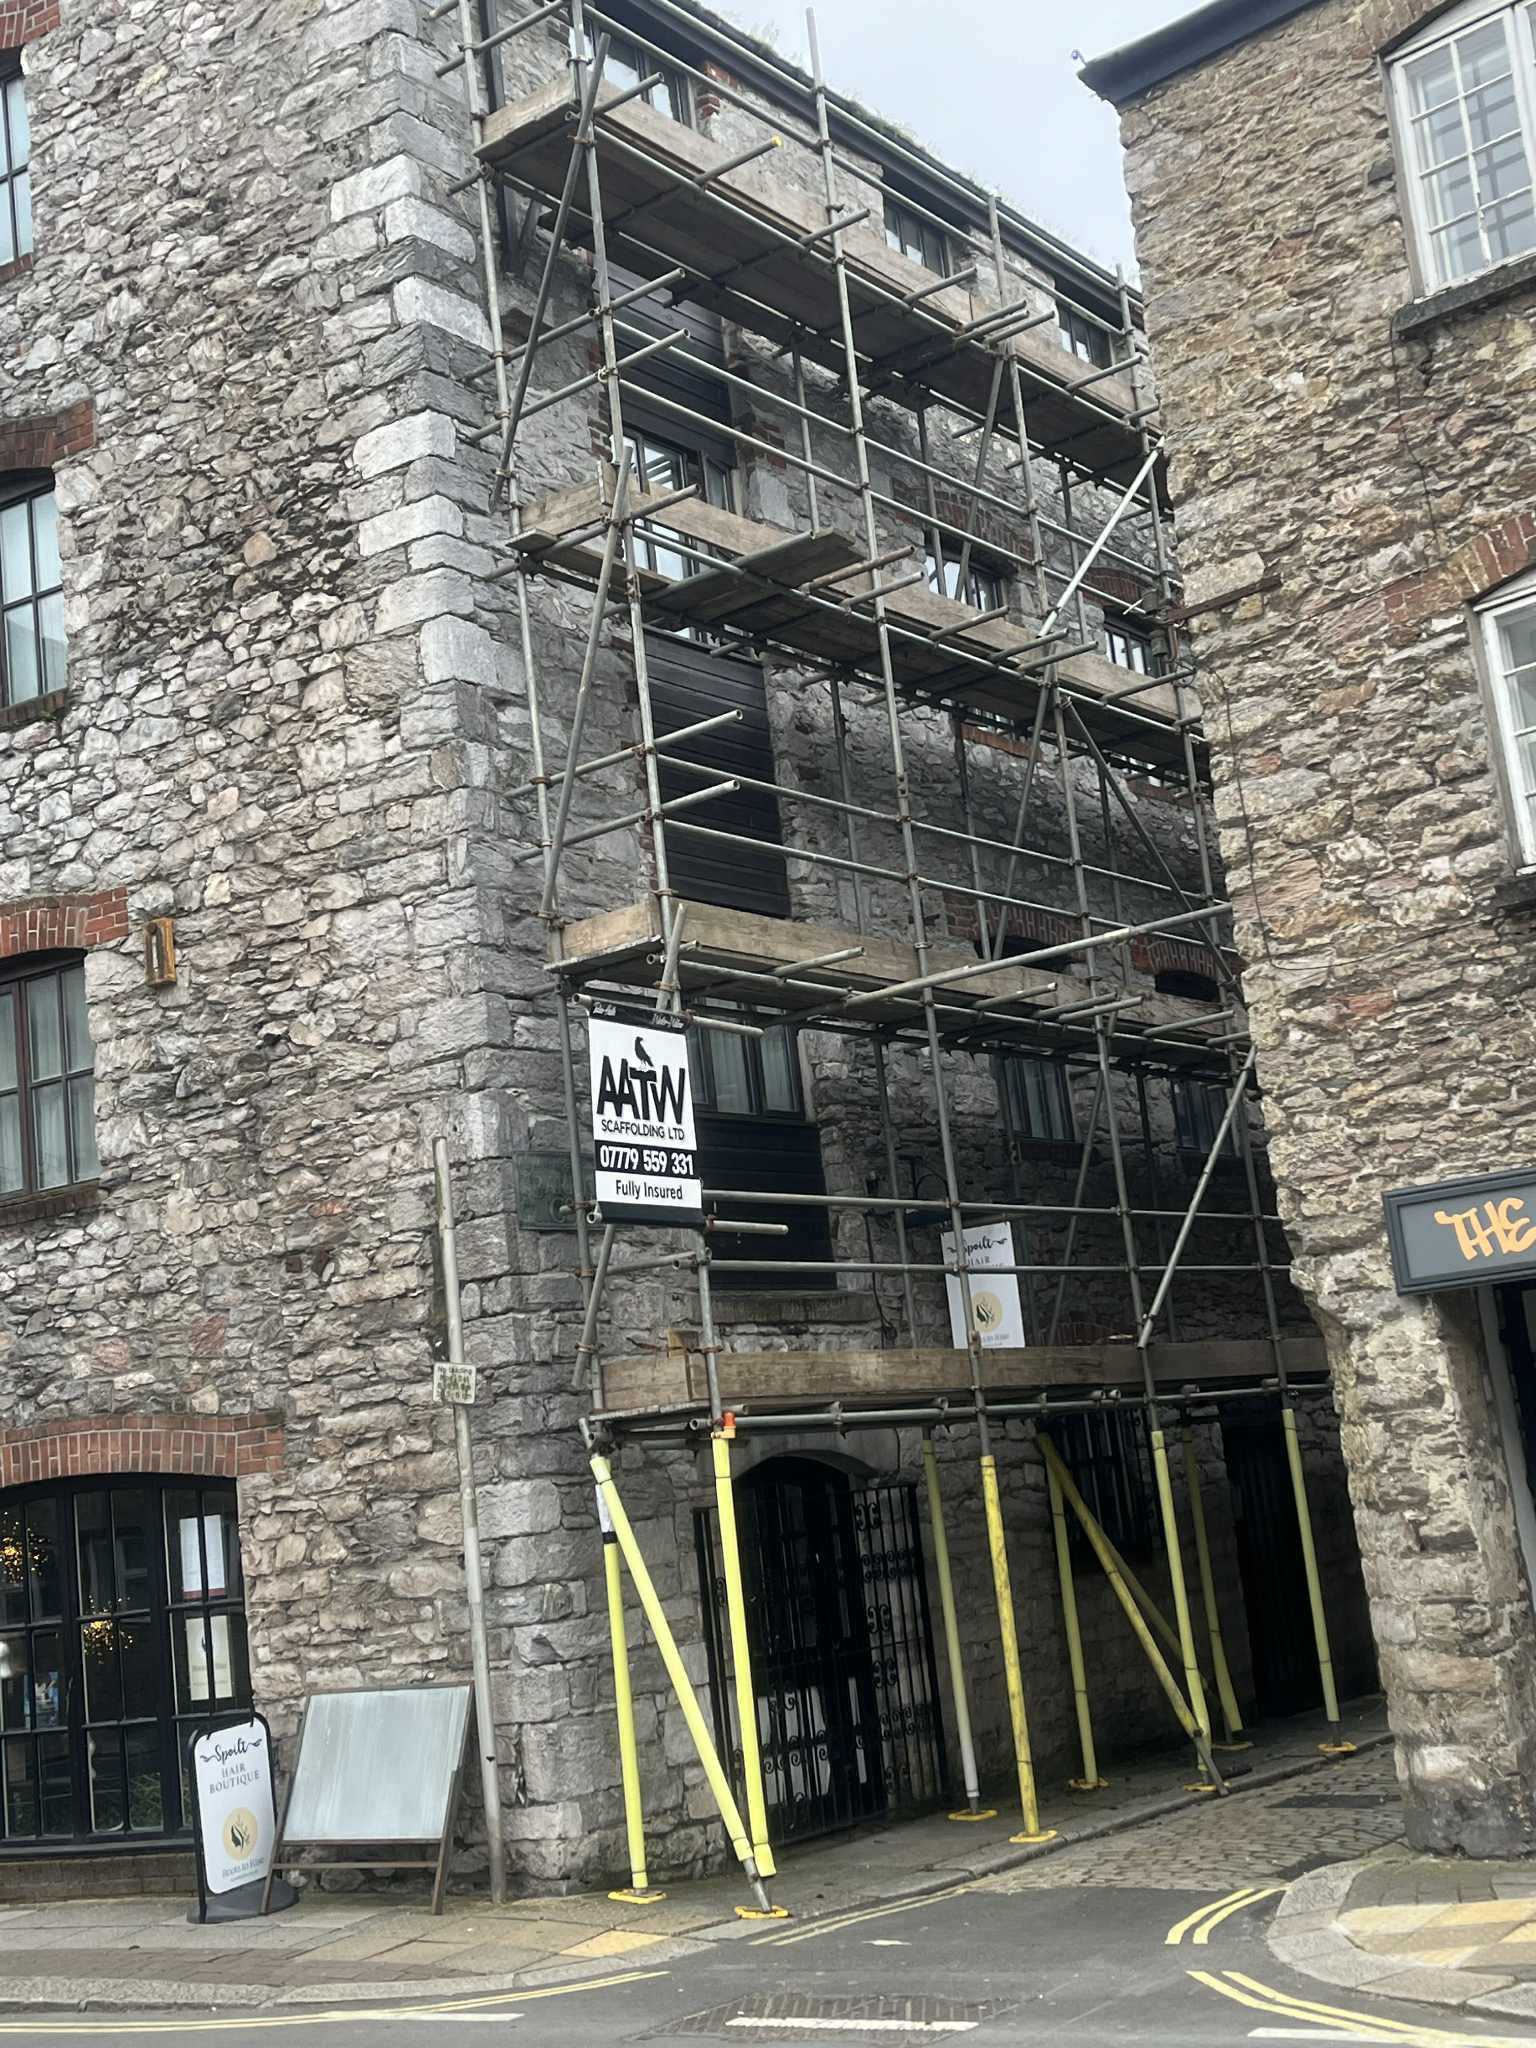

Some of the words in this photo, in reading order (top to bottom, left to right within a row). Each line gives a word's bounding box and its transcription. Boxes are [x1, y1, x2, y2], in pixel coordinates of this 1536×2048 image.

[597, 1055, 685, 1125] AATW
[602, 1119, 665, 1139] SCAFFOLDING
[668, 1127, 685, 1141] LTD
[600, 1145, 639, 1170] 07779
[642, 1149, 667, 1173] 559
[671, 1152, 694, 1176] 331
[616, 1179, 640, 1200] Fully
[643, 1181, 683, 1200] Insured
[1434, 1198, 1536, 1261] THE
[213, 1737, 249, 1765] Spoilt
[209, 1770, 260, 1794] BOUTIQUE
[221, 1763, 245, 1778] HAIR
